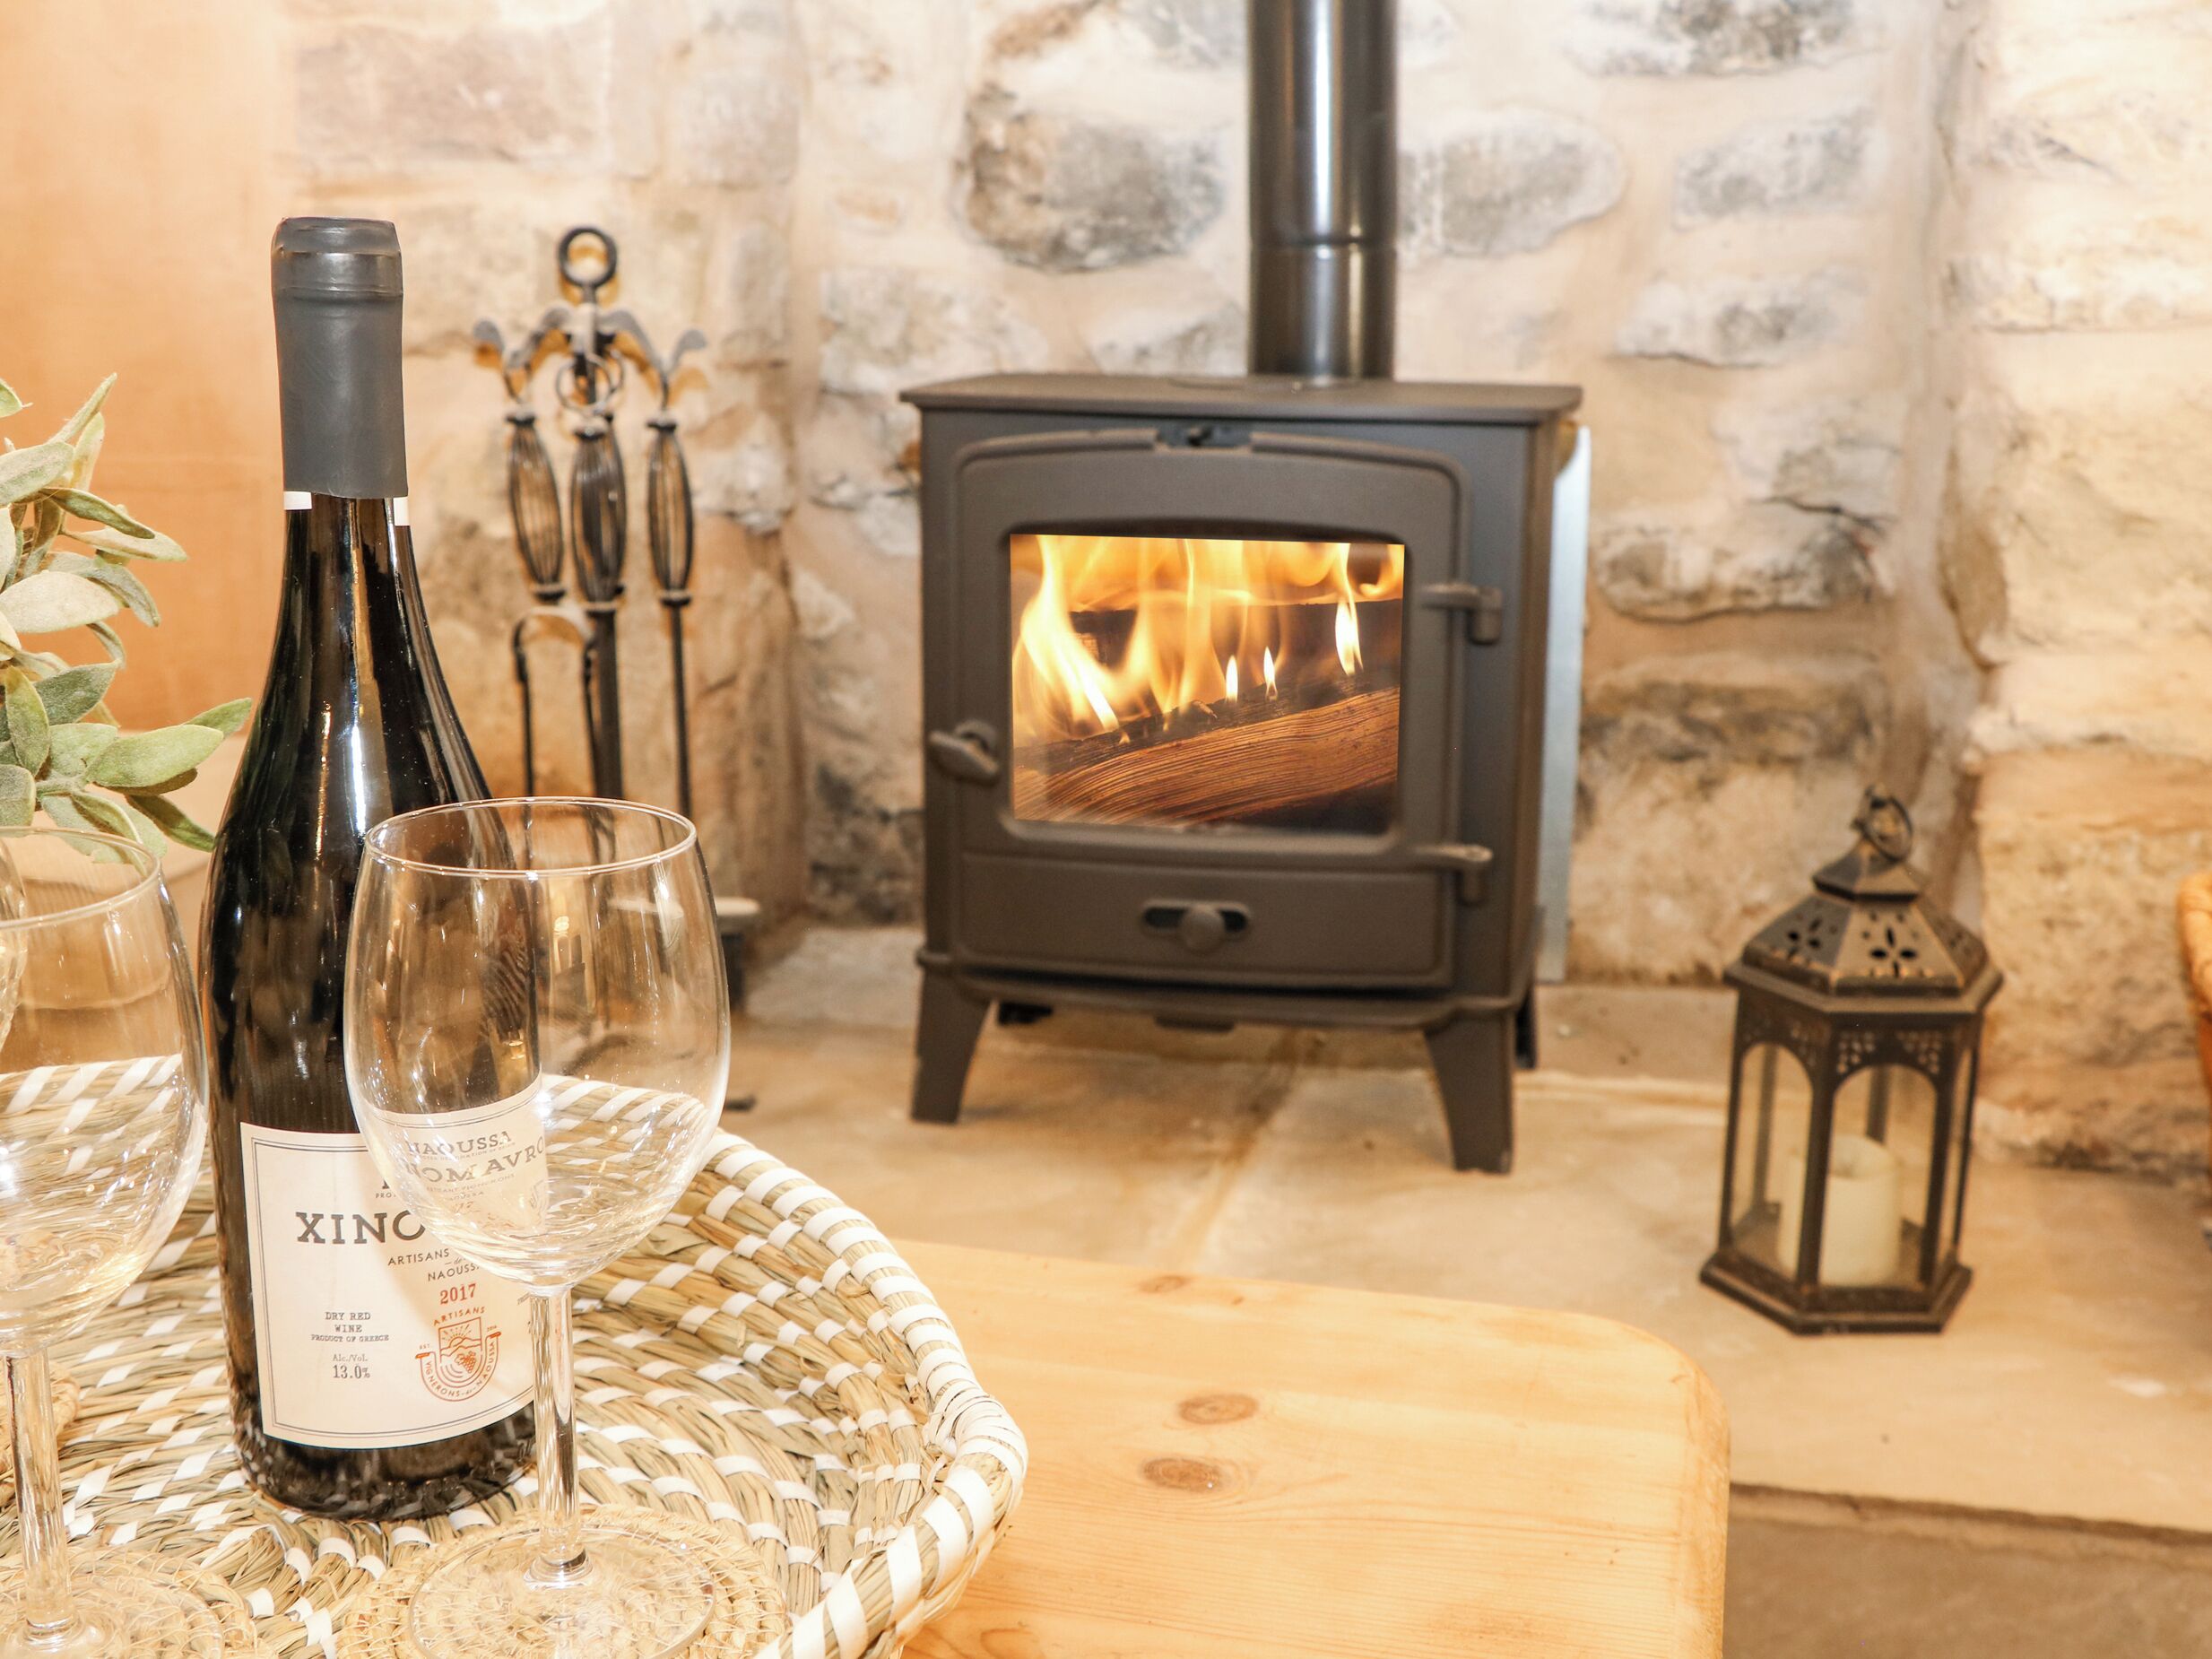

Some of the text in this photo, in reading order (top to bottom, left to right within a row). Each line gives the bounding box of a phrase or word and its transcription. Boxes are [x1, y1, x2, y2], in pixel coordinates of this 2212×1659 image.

[387, 1248, 450, 1266] ARTISANS
[428, 1264, 480, 1282] NAOUSS
[439, 1283, 476, 1305] 2017
[325, 1311, 371, 1321] DRY RED
[433, 1306, 485, 1326] ARTISANS
[310, 1334, 343, 1342] PRODUCT
[359, 1334, 389, 1342] GREECE
[334, 1325, 363, 1333] WINE
[333, 1364, 370, 1378] 13.0%
[425, 1360, 460, 1397] VIGNERONS
[476, 1342, 495, 1387] NAOUSSA
